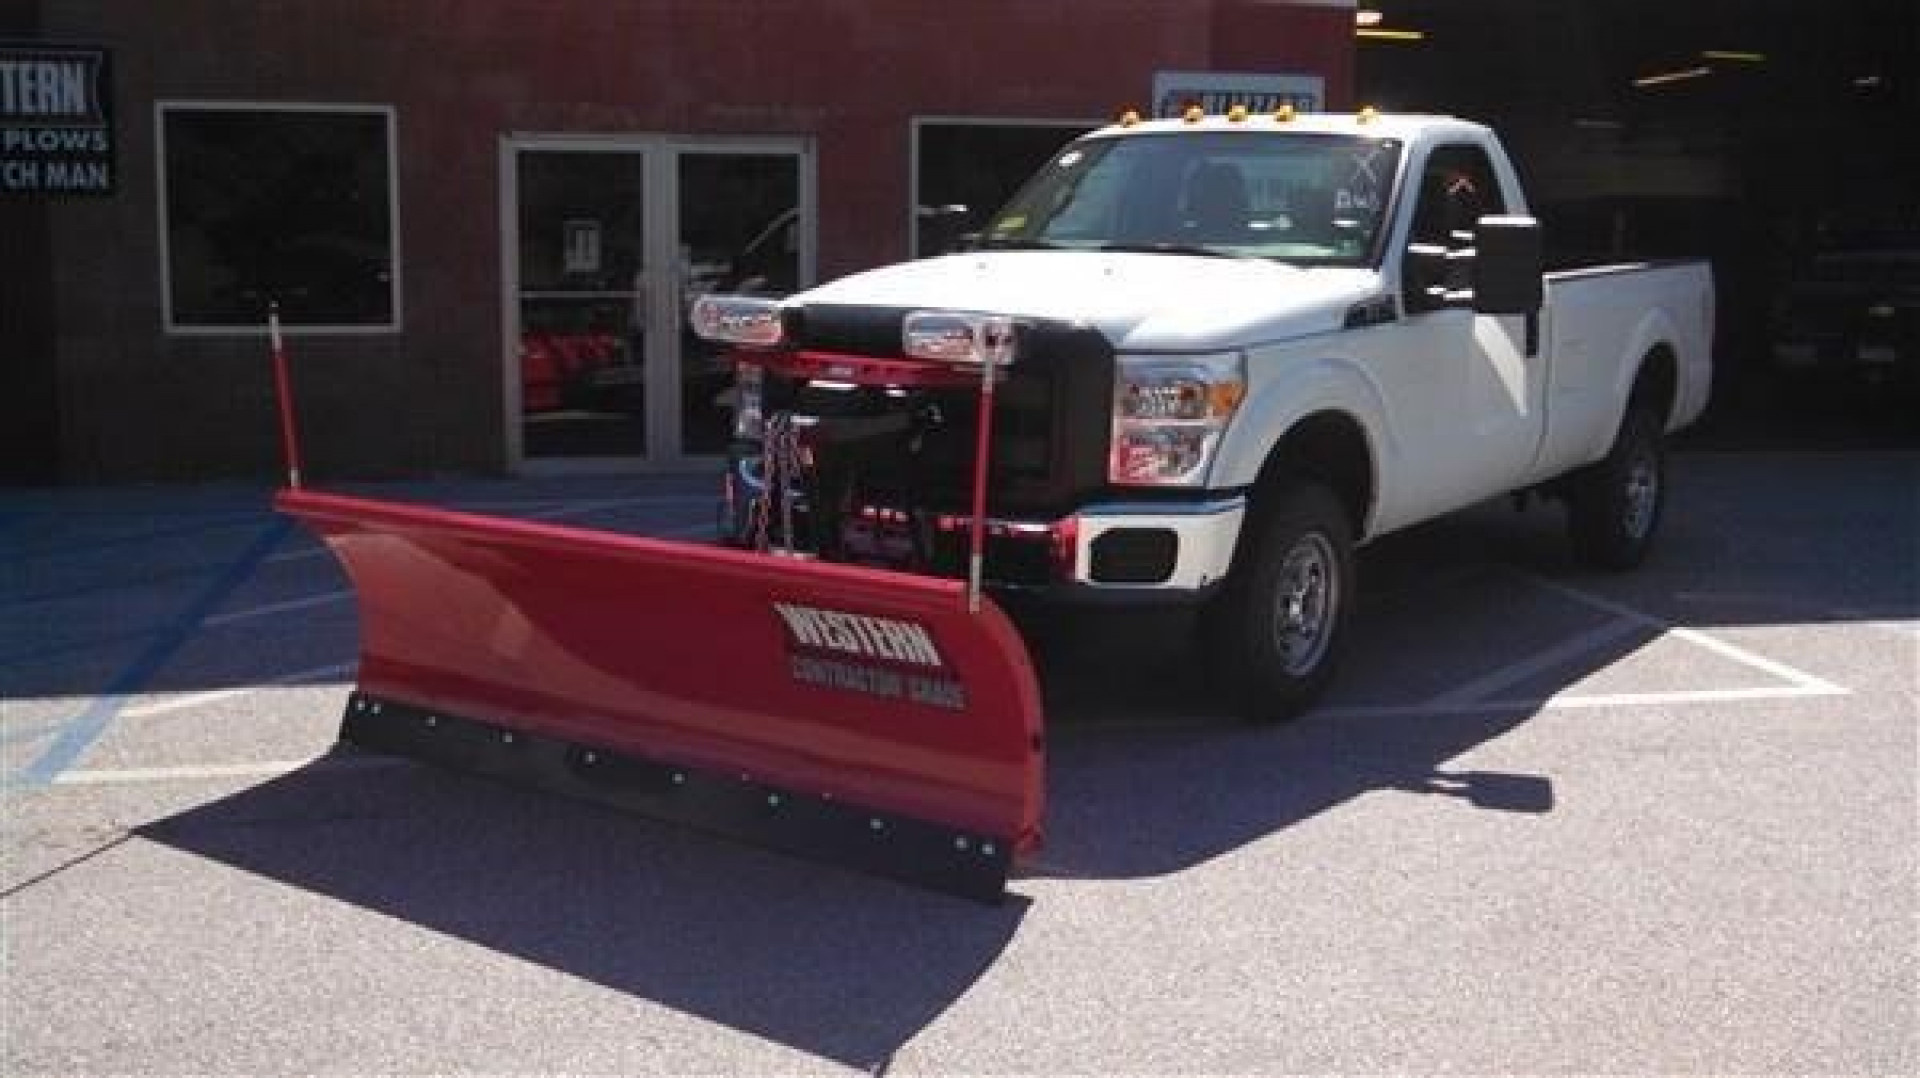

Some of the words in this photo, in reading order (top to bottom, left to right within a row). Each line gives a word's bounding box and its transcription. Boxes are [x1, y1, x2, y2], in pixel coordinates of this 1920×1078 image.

[5, 130, 109, 151] PLOWS
[0, 159, 39, 189] CH
[47, 162, 109, 189] MAN
[774, 602, 941, 665] WESTERN
